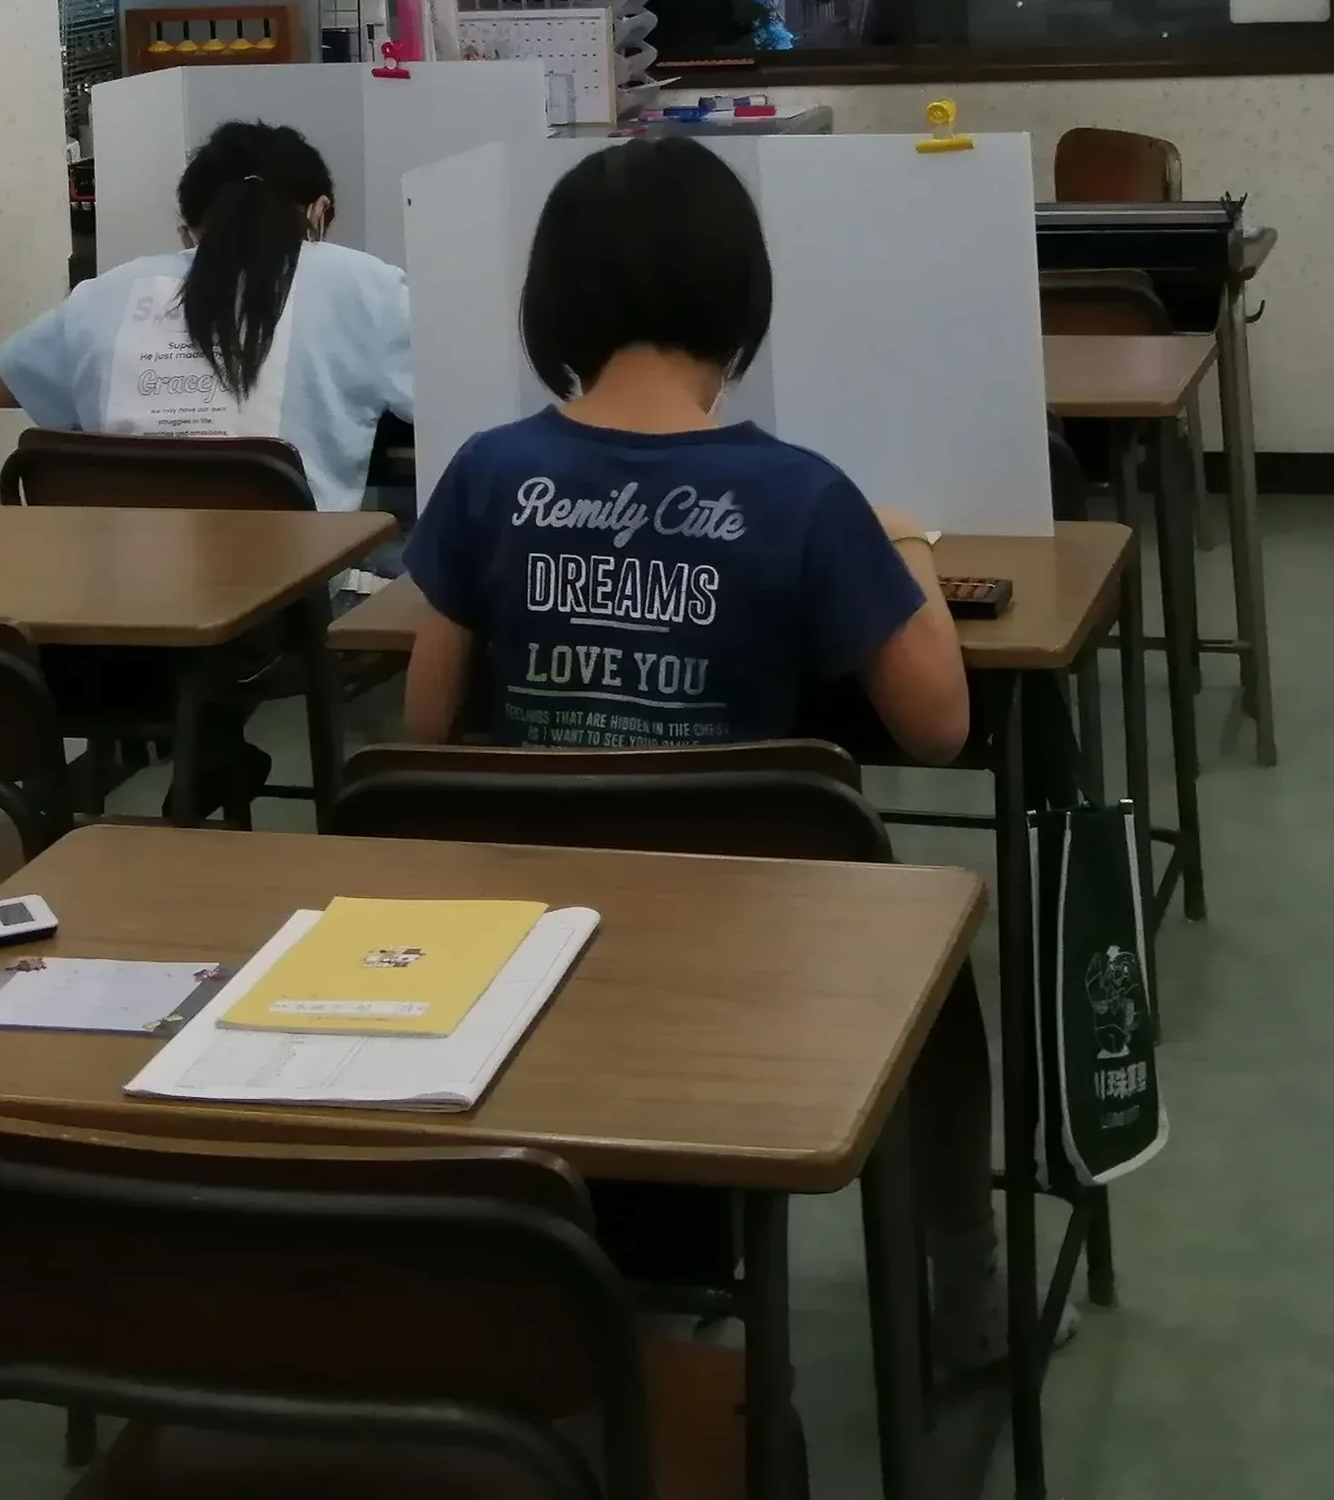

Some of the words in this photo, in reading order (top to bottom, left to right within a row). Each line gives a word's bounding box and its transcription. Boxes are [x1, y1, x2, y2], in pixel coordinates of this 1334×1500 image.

[511, 476, 650, 549] Remily
[653, 484, 748, 541] Cute
[527, 552, 719, 626] DREAMS
[526, 642, 623, 687] LOVE
[633, 652, 709, 696] YOU
[550, 727, 585, 743] WANT
[587, 730, 601, 746] TO
[604, 733, 624, 747] SEE
[555, 710, 584, 726] THAT
[585, 712, 607, 728] ARE
[651, 721, 664, 736] IN
[667, 723, 691, 738] THE
